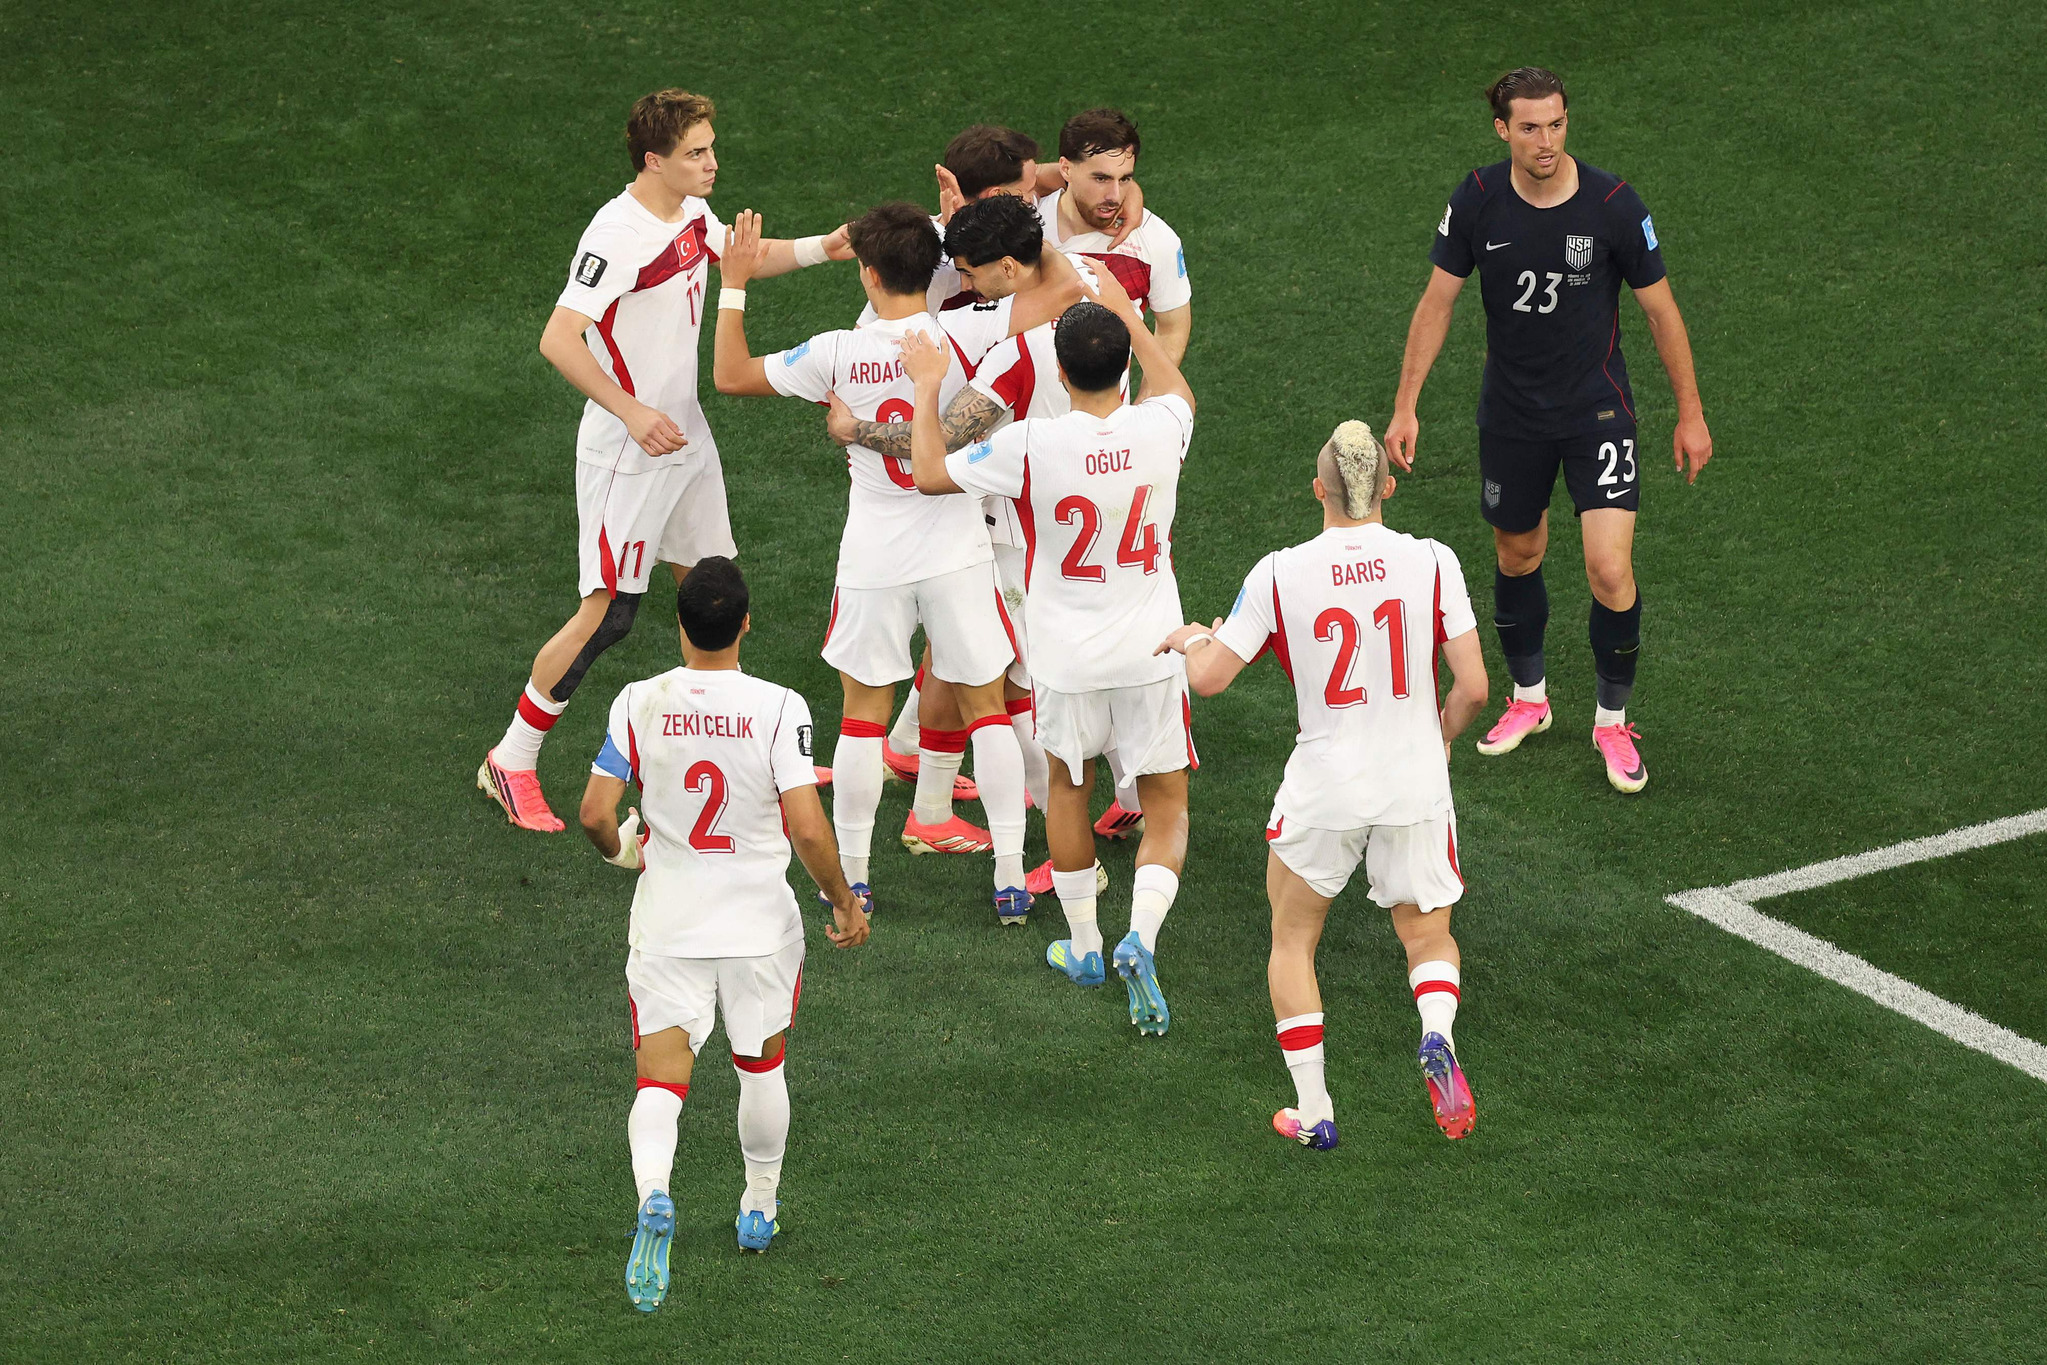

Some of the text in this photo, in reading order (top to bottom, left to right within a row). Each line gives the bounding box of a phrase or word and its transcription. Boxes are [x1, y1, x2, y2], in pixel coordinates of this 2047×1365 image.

[1569, 237, 1591, 252] USA
[1512, 270, 1563, 314] 23
[1085, 448, 1132, 475] OĞUZ
[1597, 438, 1636, 486] 23
[1055, 484, 1162, 583] 24
[618, 540, 646, 579] 11
[1331, 558, 1387, 586] BARIŞ
[1313, 598, 1410, 709] 21
[662, 710, 753, 739] ZEKİ ÇELİK
[684, 760, 736, 854] 2
